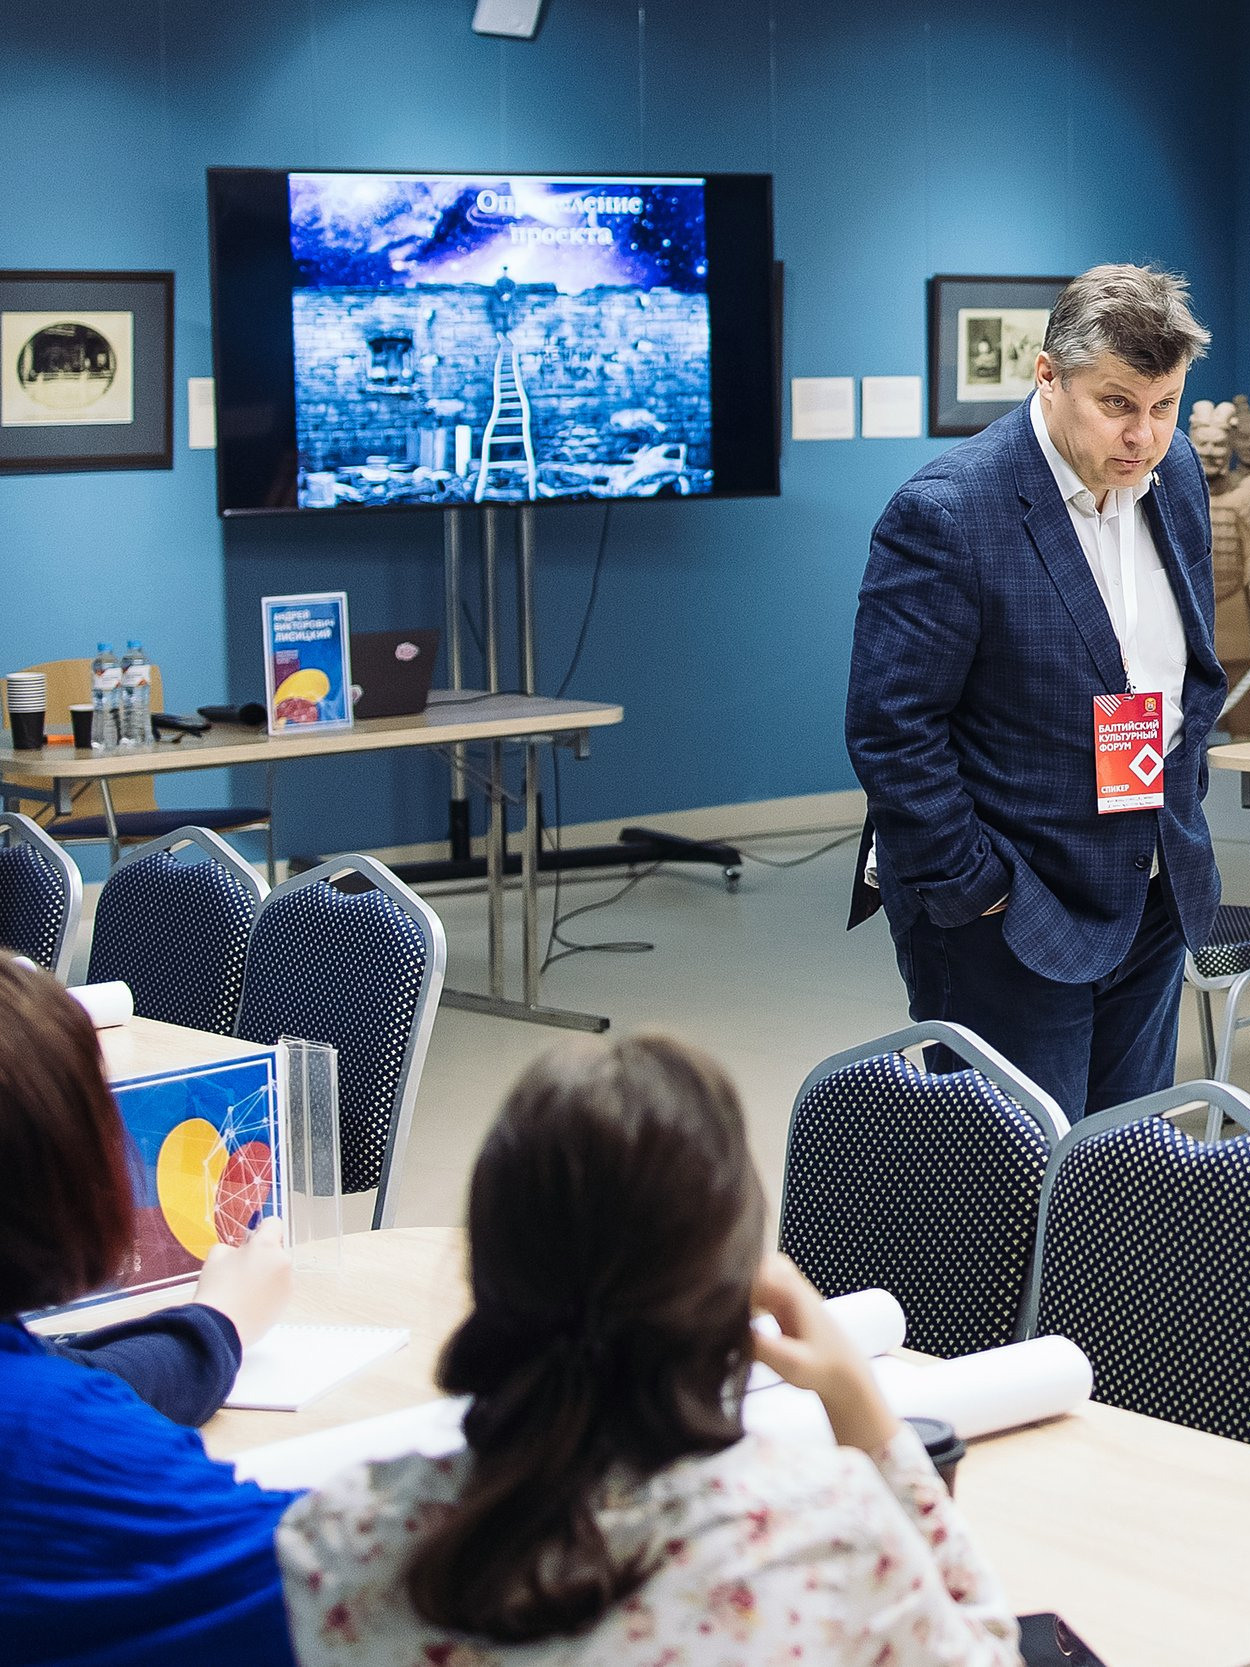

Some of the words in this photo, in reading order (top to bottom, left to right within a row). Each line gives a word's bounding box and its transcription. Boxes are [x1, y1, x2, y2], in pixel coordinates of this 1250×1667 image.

[511, 226, 613, 246] проекта
[274, 619, 335, 632] ВИКТОРОВИЧ
[1098, 719, 1159, 733] БАЛТИЙСКИЙ
[1099, 730, 1157, 742] КУЛЬТУРНЫЙ
[1099, 742, 1131, 752] ФОРУМ
[1101, 785, 1129, 793] СПИКЕР
